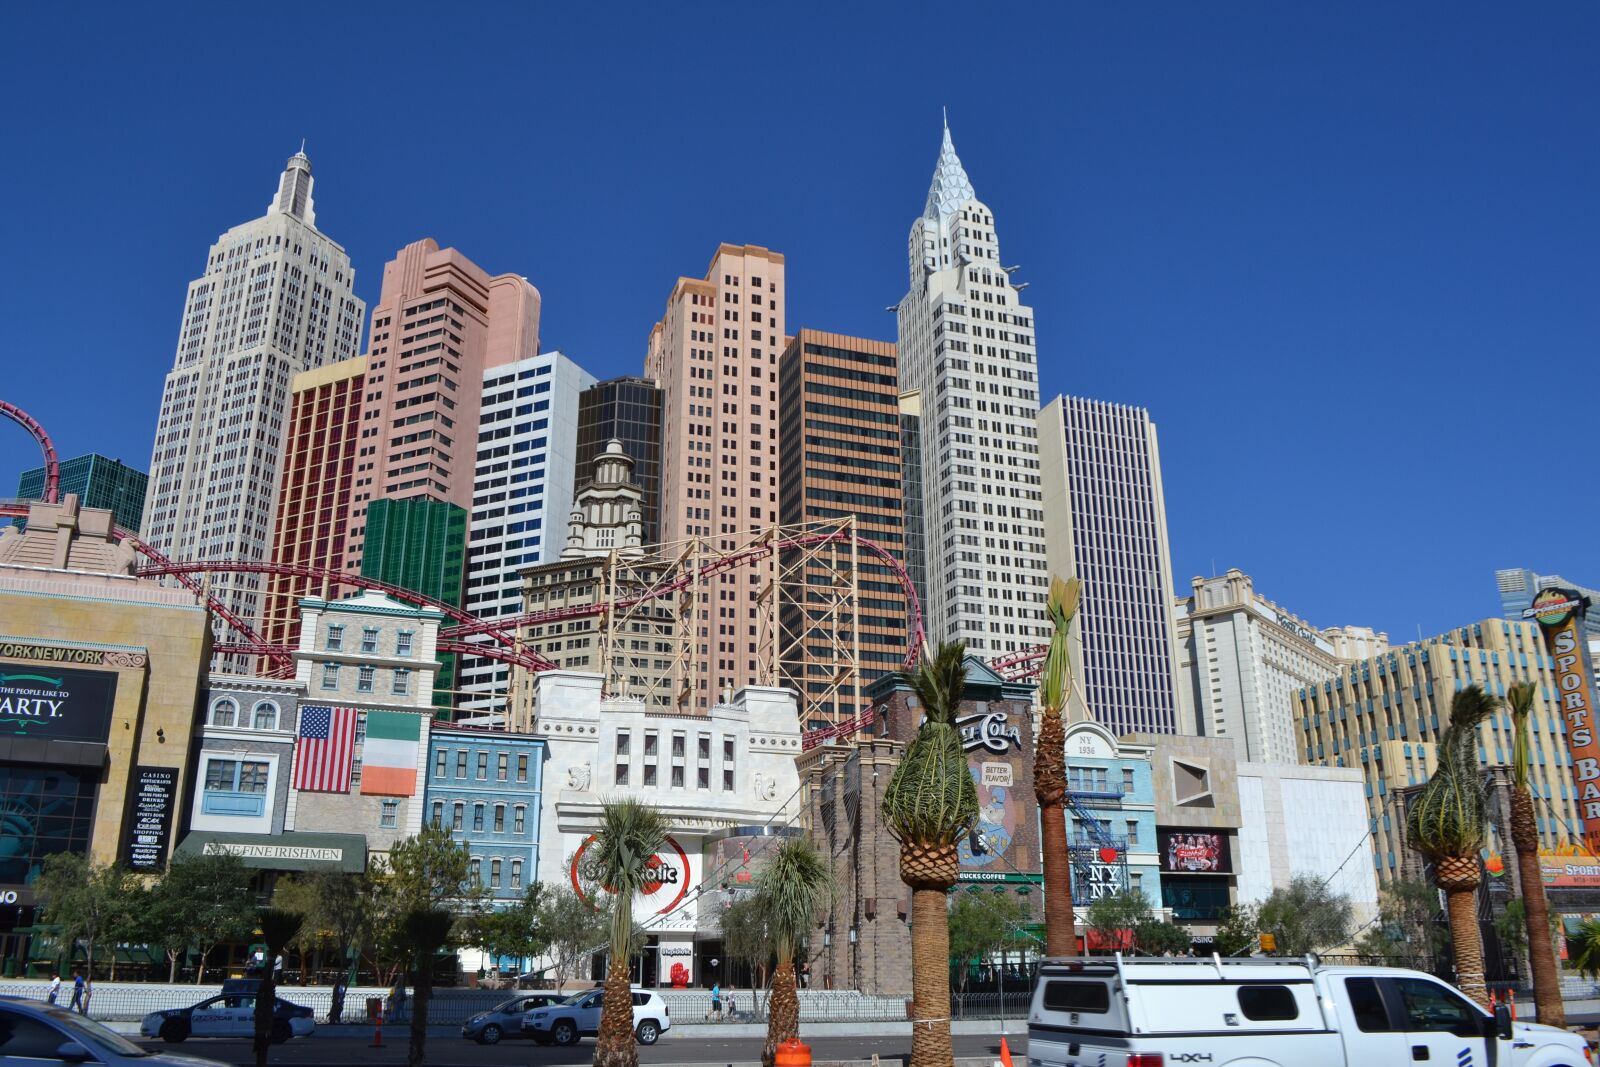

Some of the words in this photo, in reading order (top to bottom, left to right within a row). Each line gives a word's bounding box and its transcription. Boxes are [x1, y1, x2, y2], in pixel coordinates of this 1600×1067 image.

[34, 646, 65, 661] NEW
[67, 649, 103, 664] YORK
[16, 688, 41, 696] PEOPLE
[1554, 629, 1592, 748] SPORTS
[0, 696, 64, 717] ARTY.
[1079, 736, 1092, 744] NY
[985, 766, 1008, 774] BETTER
[1575, 757, 1600, 820] BAR
[679, 817, 705, 826] NEW
[241, 846, 273, 858] FINE
[274, 847, 340, 860] IRISHMEN
[1090, 848, 1100, 863] I
[1089, 865, 1121, 881] NY
[1090, 883, 1121, 899] NY
